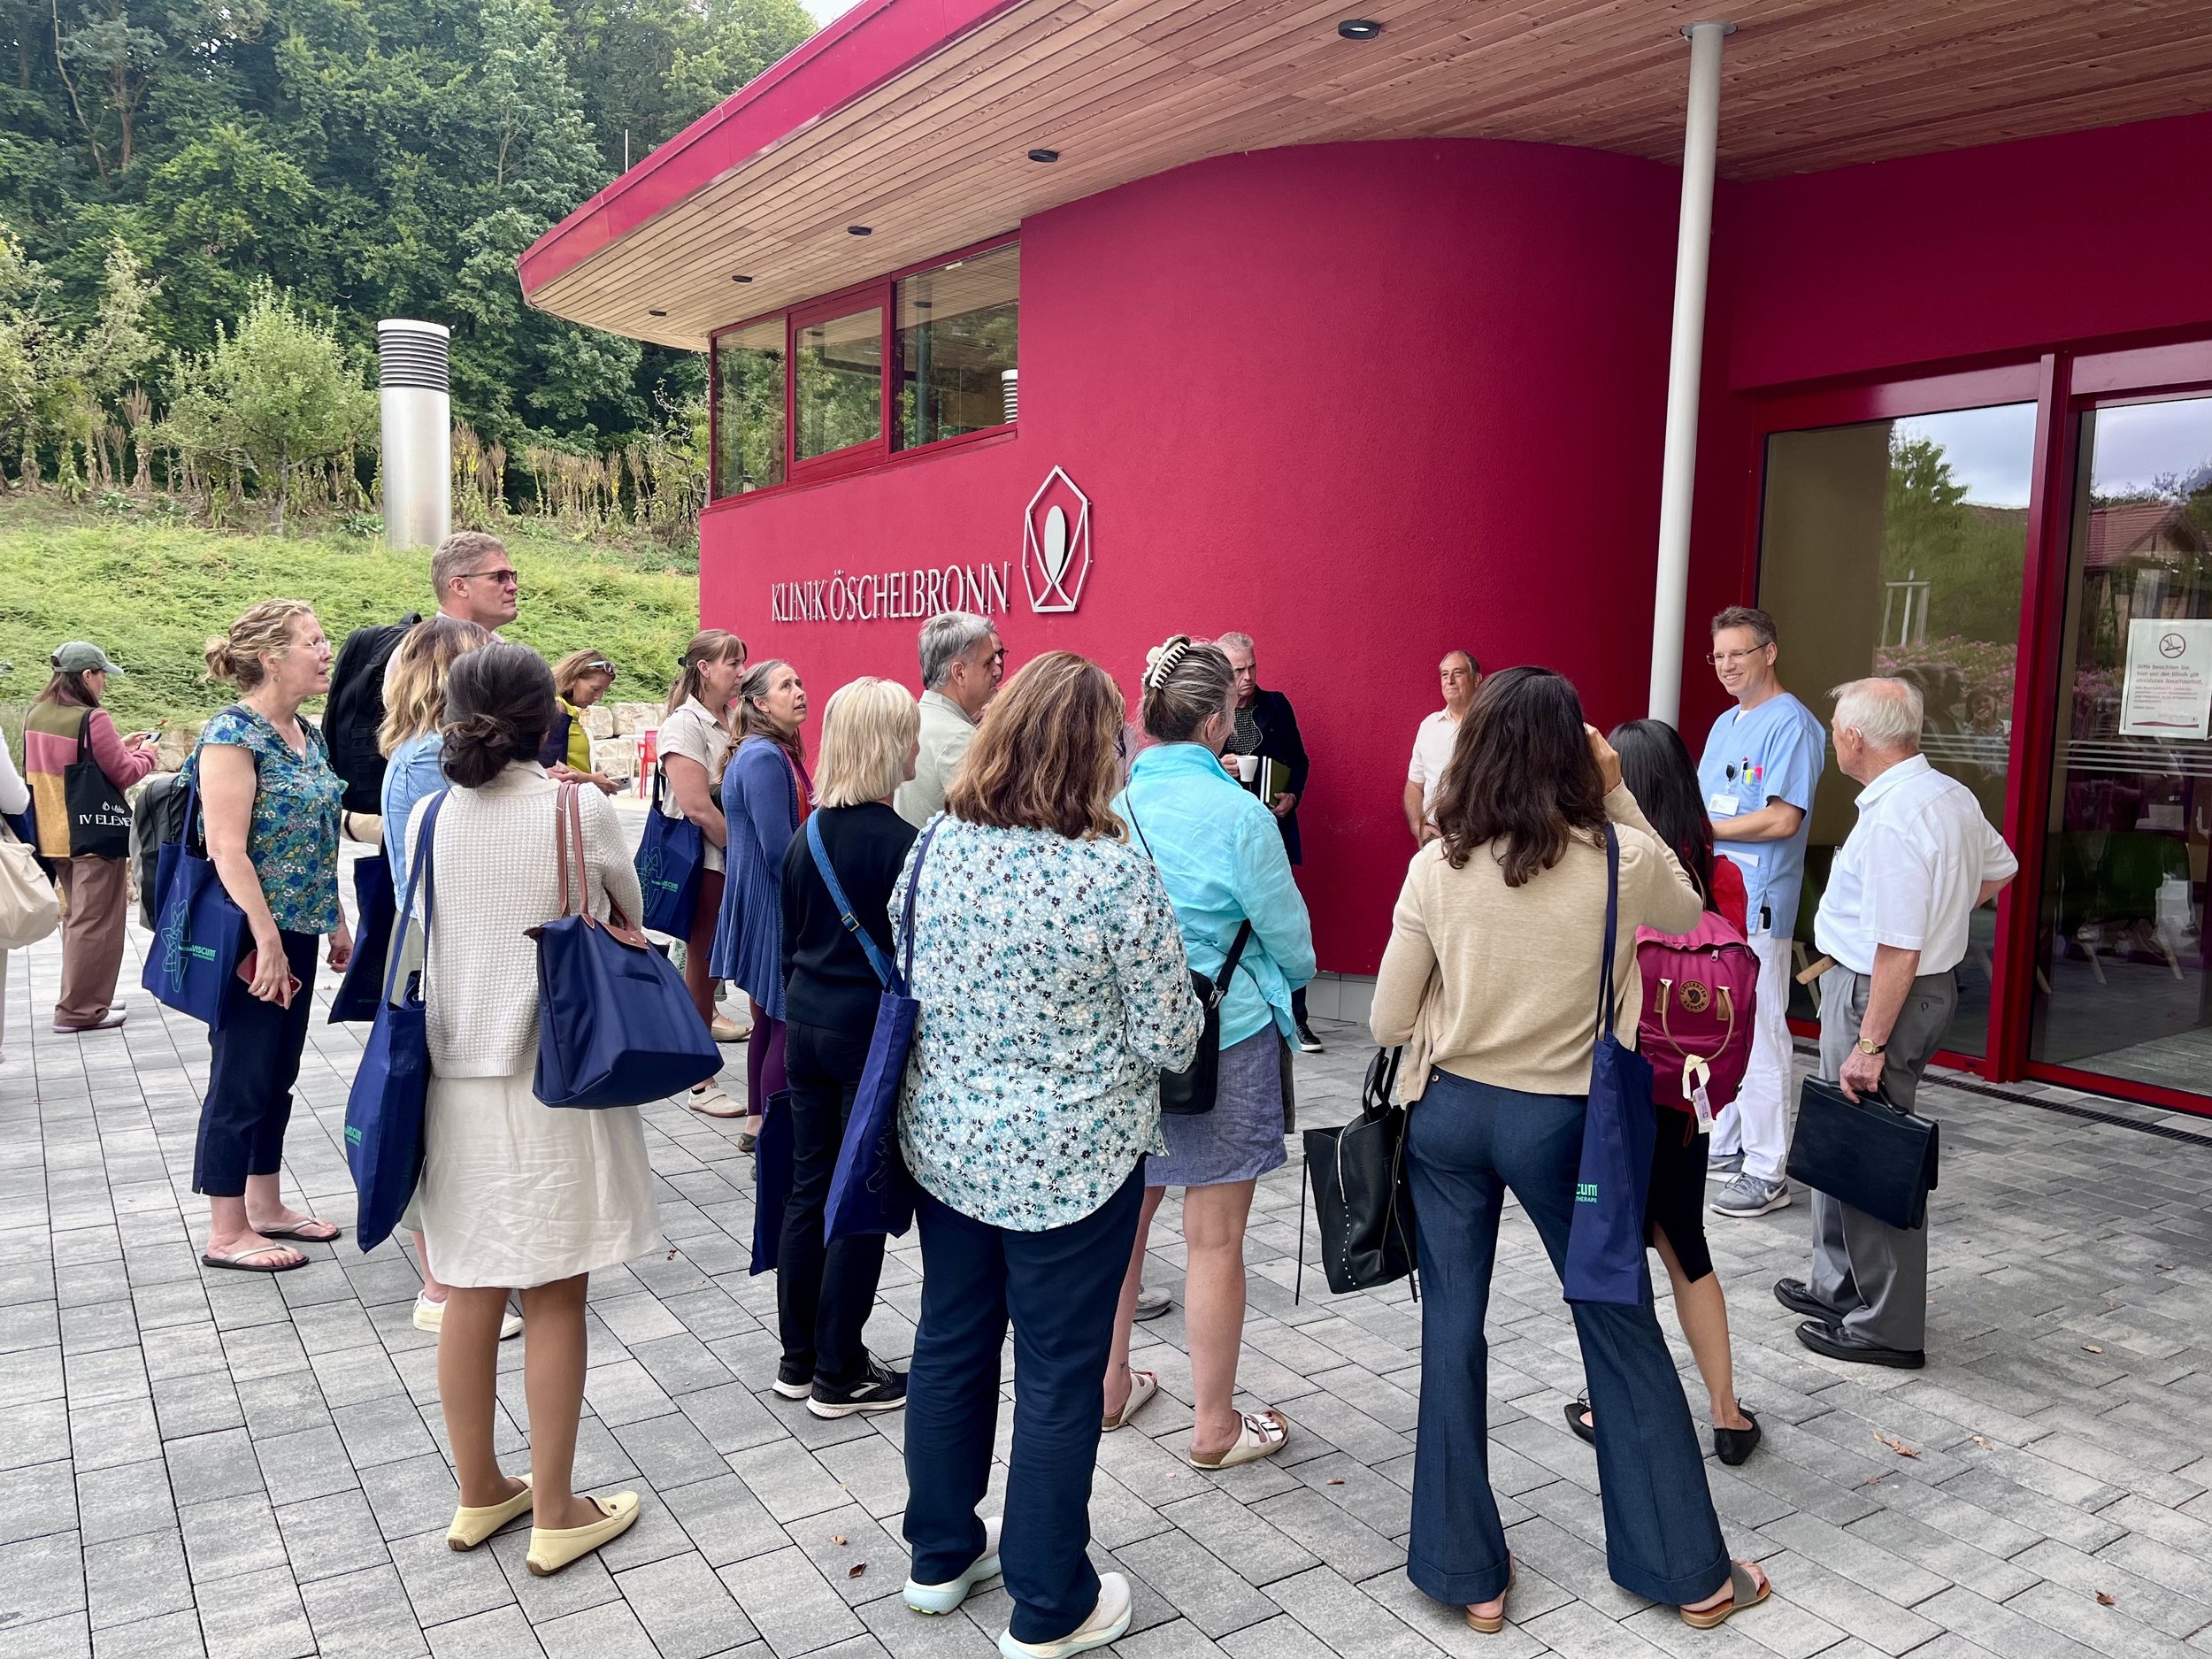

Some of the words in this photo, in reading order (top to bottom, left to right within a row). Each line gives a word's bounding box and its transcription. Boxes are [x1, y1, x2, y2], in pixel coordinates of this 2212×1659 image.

[771, 579, 828, 622] KLINIK
[829, 560, 1010, 622] ÖSCHELBRONN
[79, 814, 92, 825] IV
